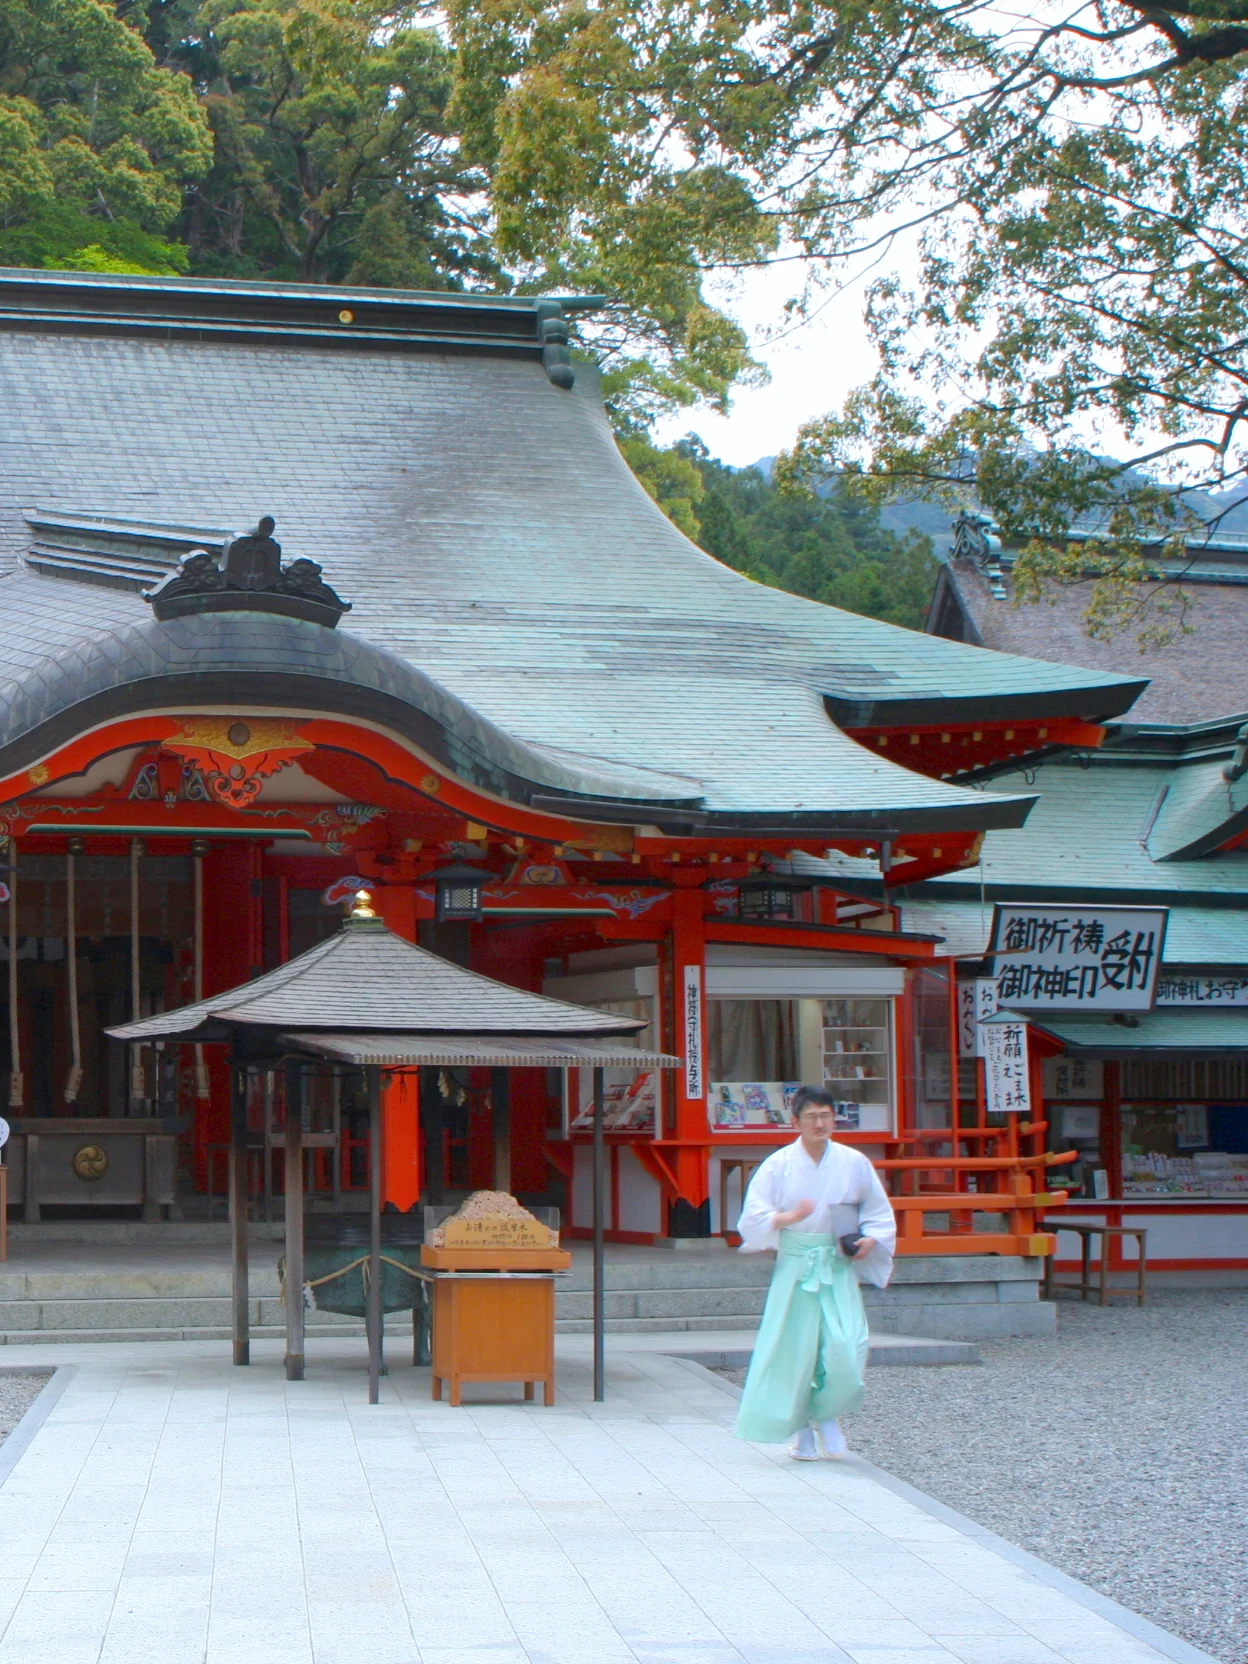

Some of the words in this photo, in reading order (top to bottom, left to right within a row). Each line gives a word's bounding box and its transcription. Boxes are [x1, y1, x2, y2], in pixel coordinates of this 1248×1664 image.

[1003, 916, 1105, 954] 御祈祷
[1098, 929, 1155, 990] 受付
[996, 963, 1099, 1000] 御神印
[1003, 1024, 1023, 1059] 祈願
